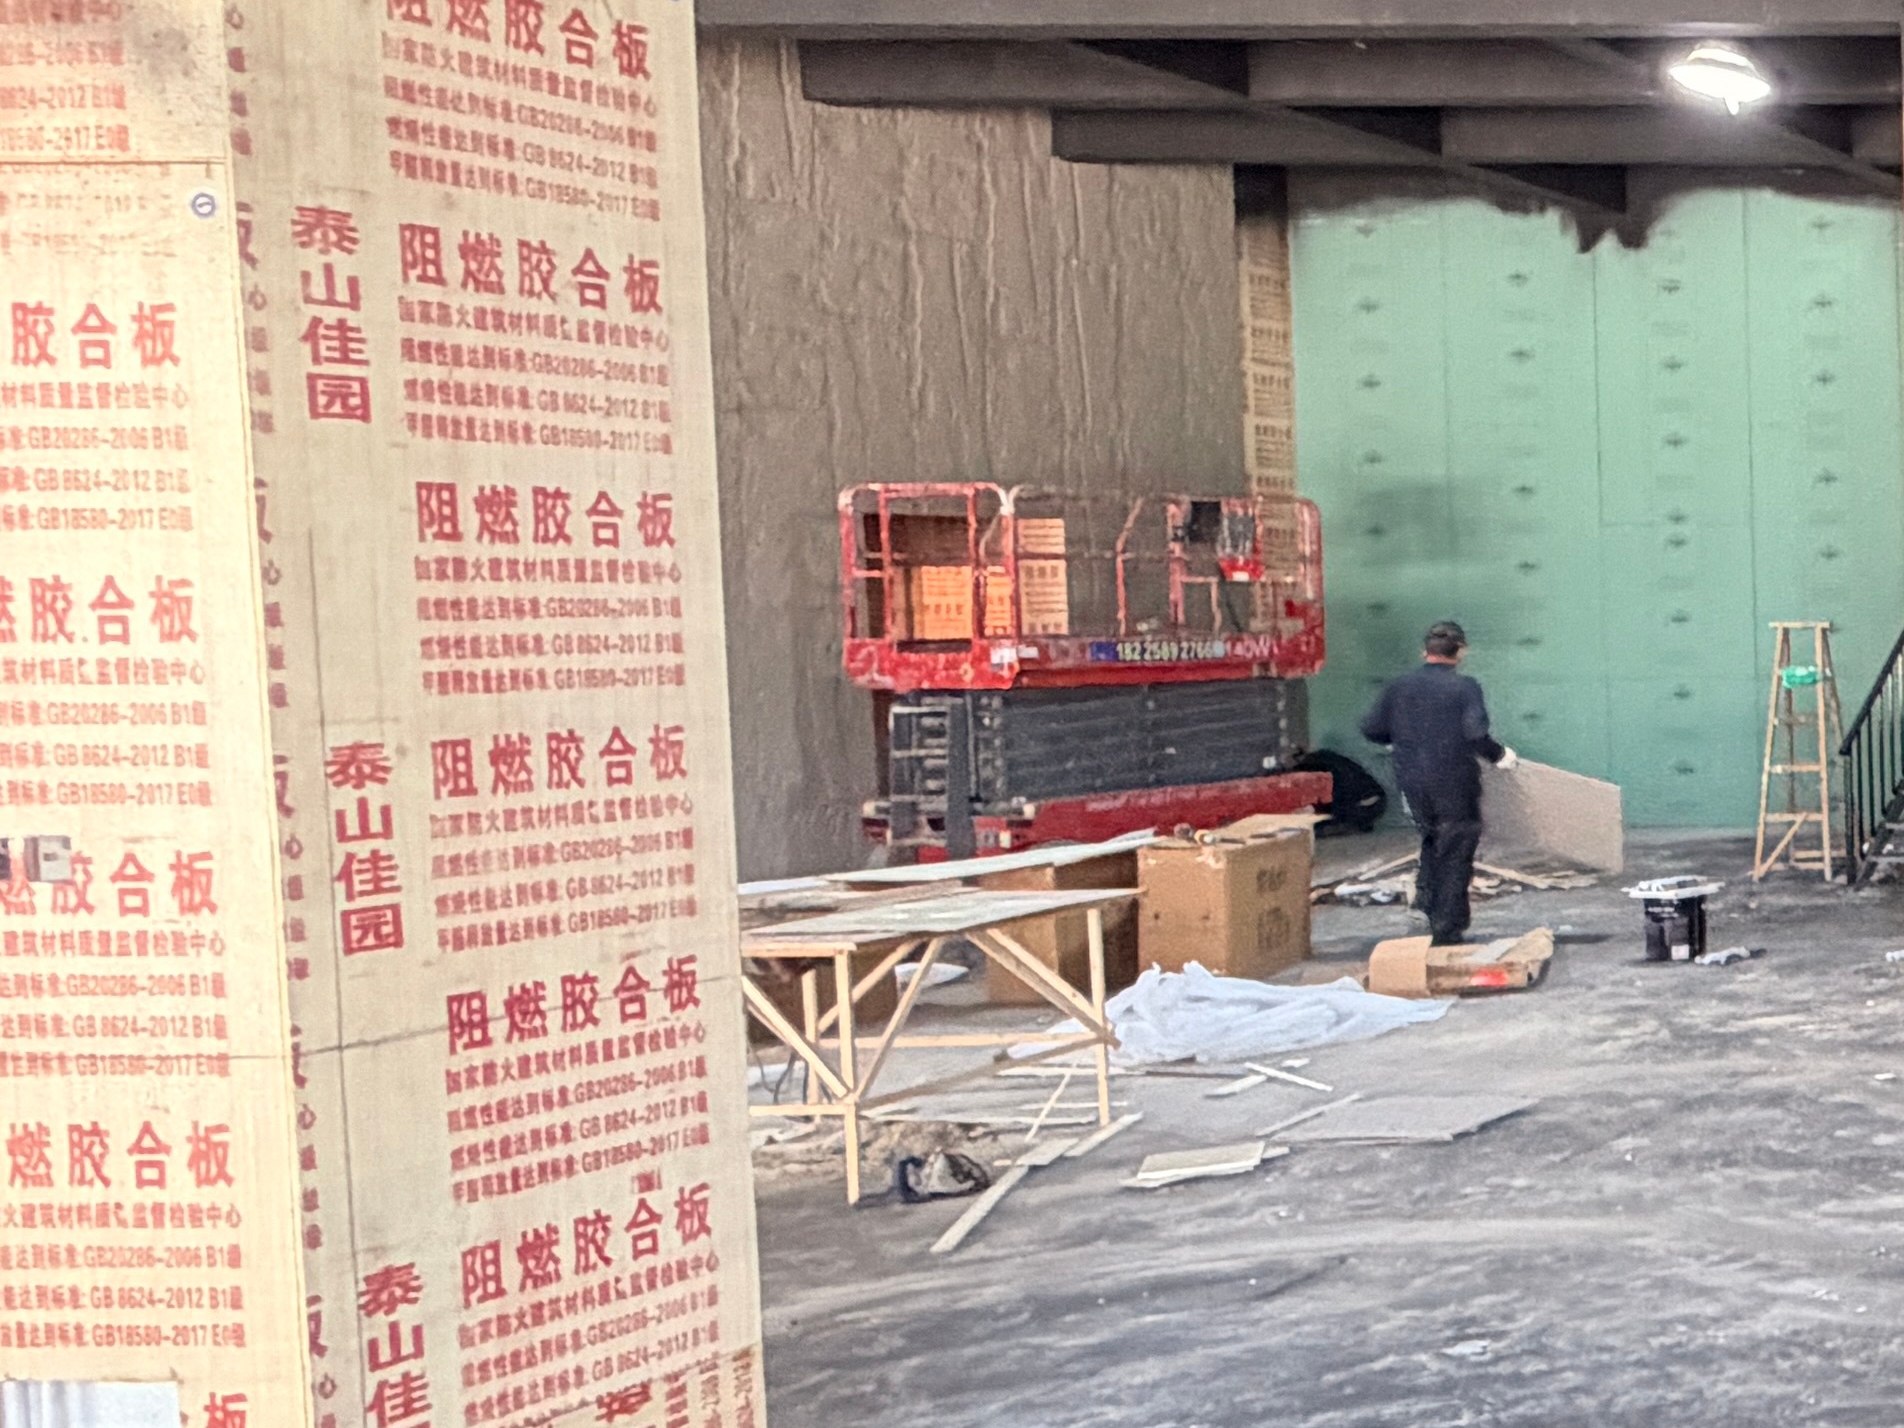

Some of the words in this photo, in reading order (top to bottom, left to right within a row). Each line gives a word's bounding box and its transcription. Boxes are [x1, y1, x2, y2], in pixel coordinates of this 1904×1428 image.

[400, 223, 663, 314] 阻燃胶合板
[9, 300, 180, 369] 胶合板
[291, 205, 371, 424] 泰山佳园
[416, 481, 676, 548] 阻燃胶合板
[431, 725, 688, 800] 阻燃胶合板
[325, 742, 403, 956] 泰山佳园
[447, 955, 701, 1054] 阻燃胶合板
[4, 1121, 234, 1190] 燃胶合板
[460, 1182, 713, 1309] 阻燃胶合板
